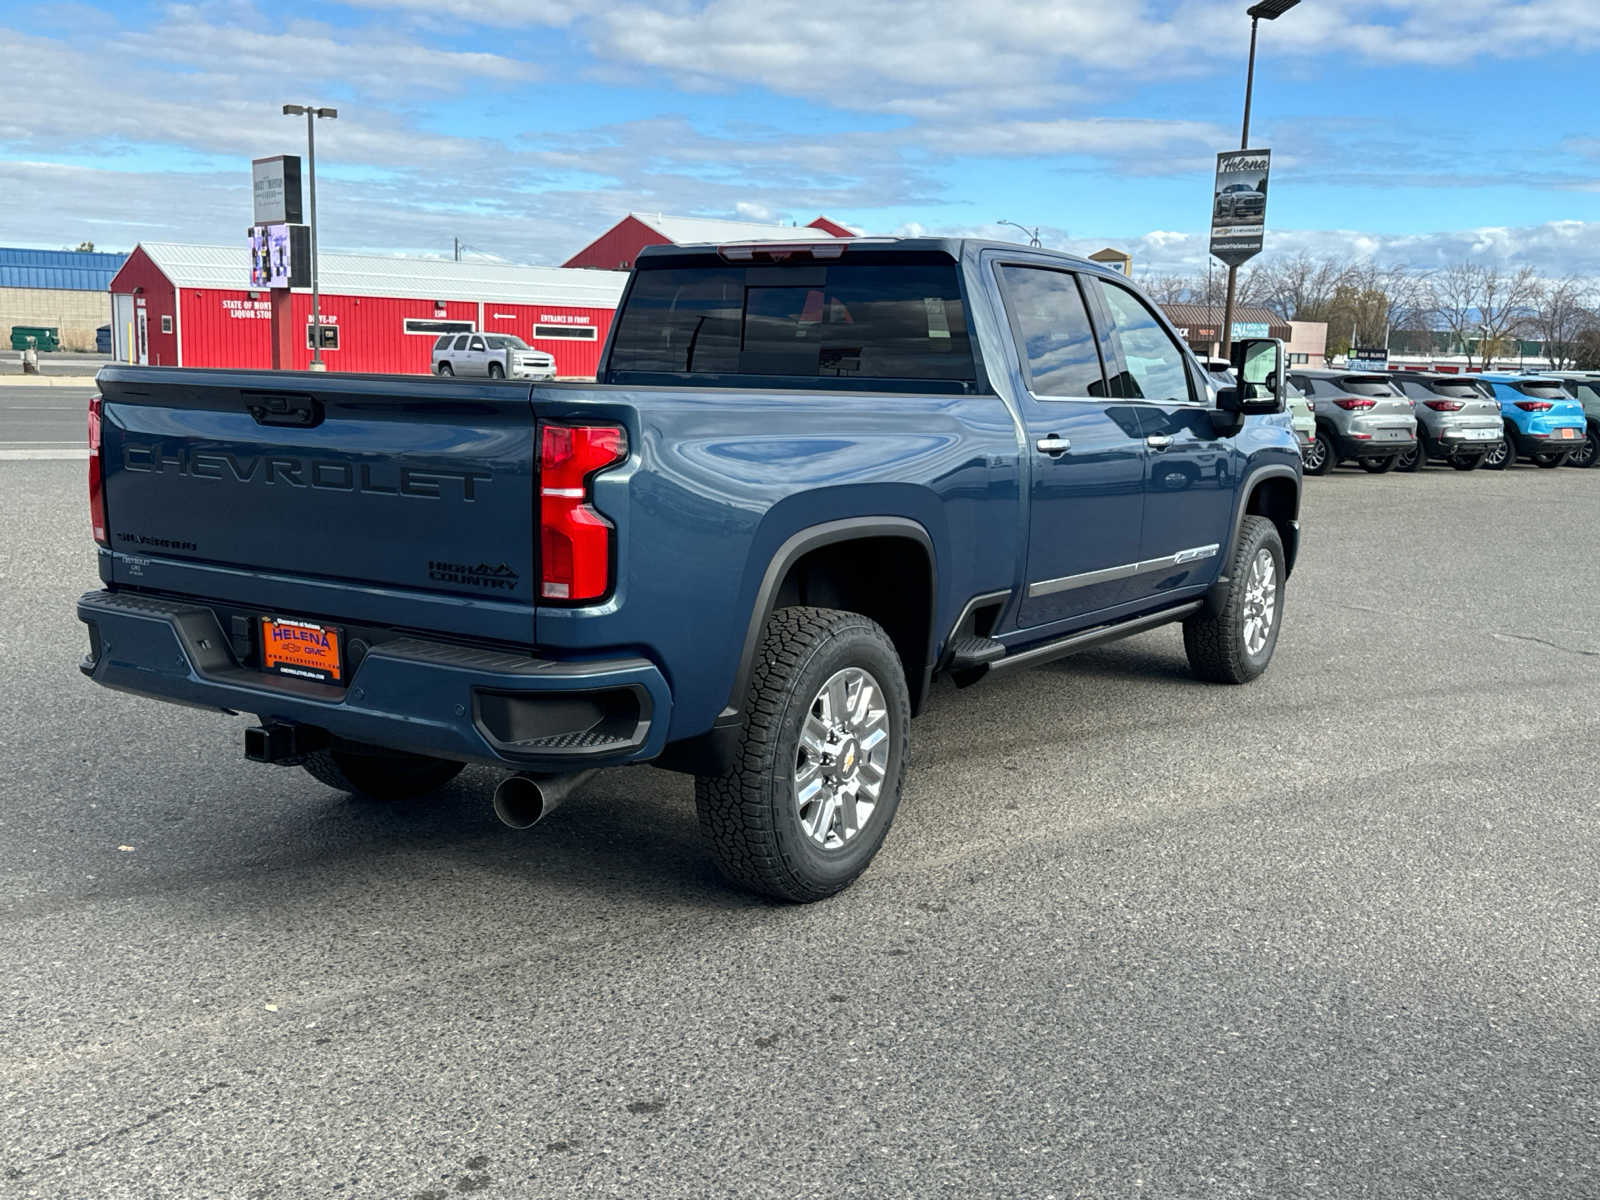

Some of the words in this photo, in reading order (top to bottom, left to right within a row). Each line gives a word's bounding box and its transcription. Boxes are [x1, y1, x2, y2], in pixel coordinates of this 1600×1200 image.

[1222, 157, 1268, 173] Helena
[222, 300, 242, 309] STATE
[243, 301, 253, 309] OF
[230, 310, 255, 319] LIQUOR
[123, 445, 493, 503] CHEVROLET
[428, 560, 473, 575] HIGH
[428, 571, 519, 591] COUNTRY
[272, 627, 331, 650] HELENA
[304, 646, 327, 657] GMC
